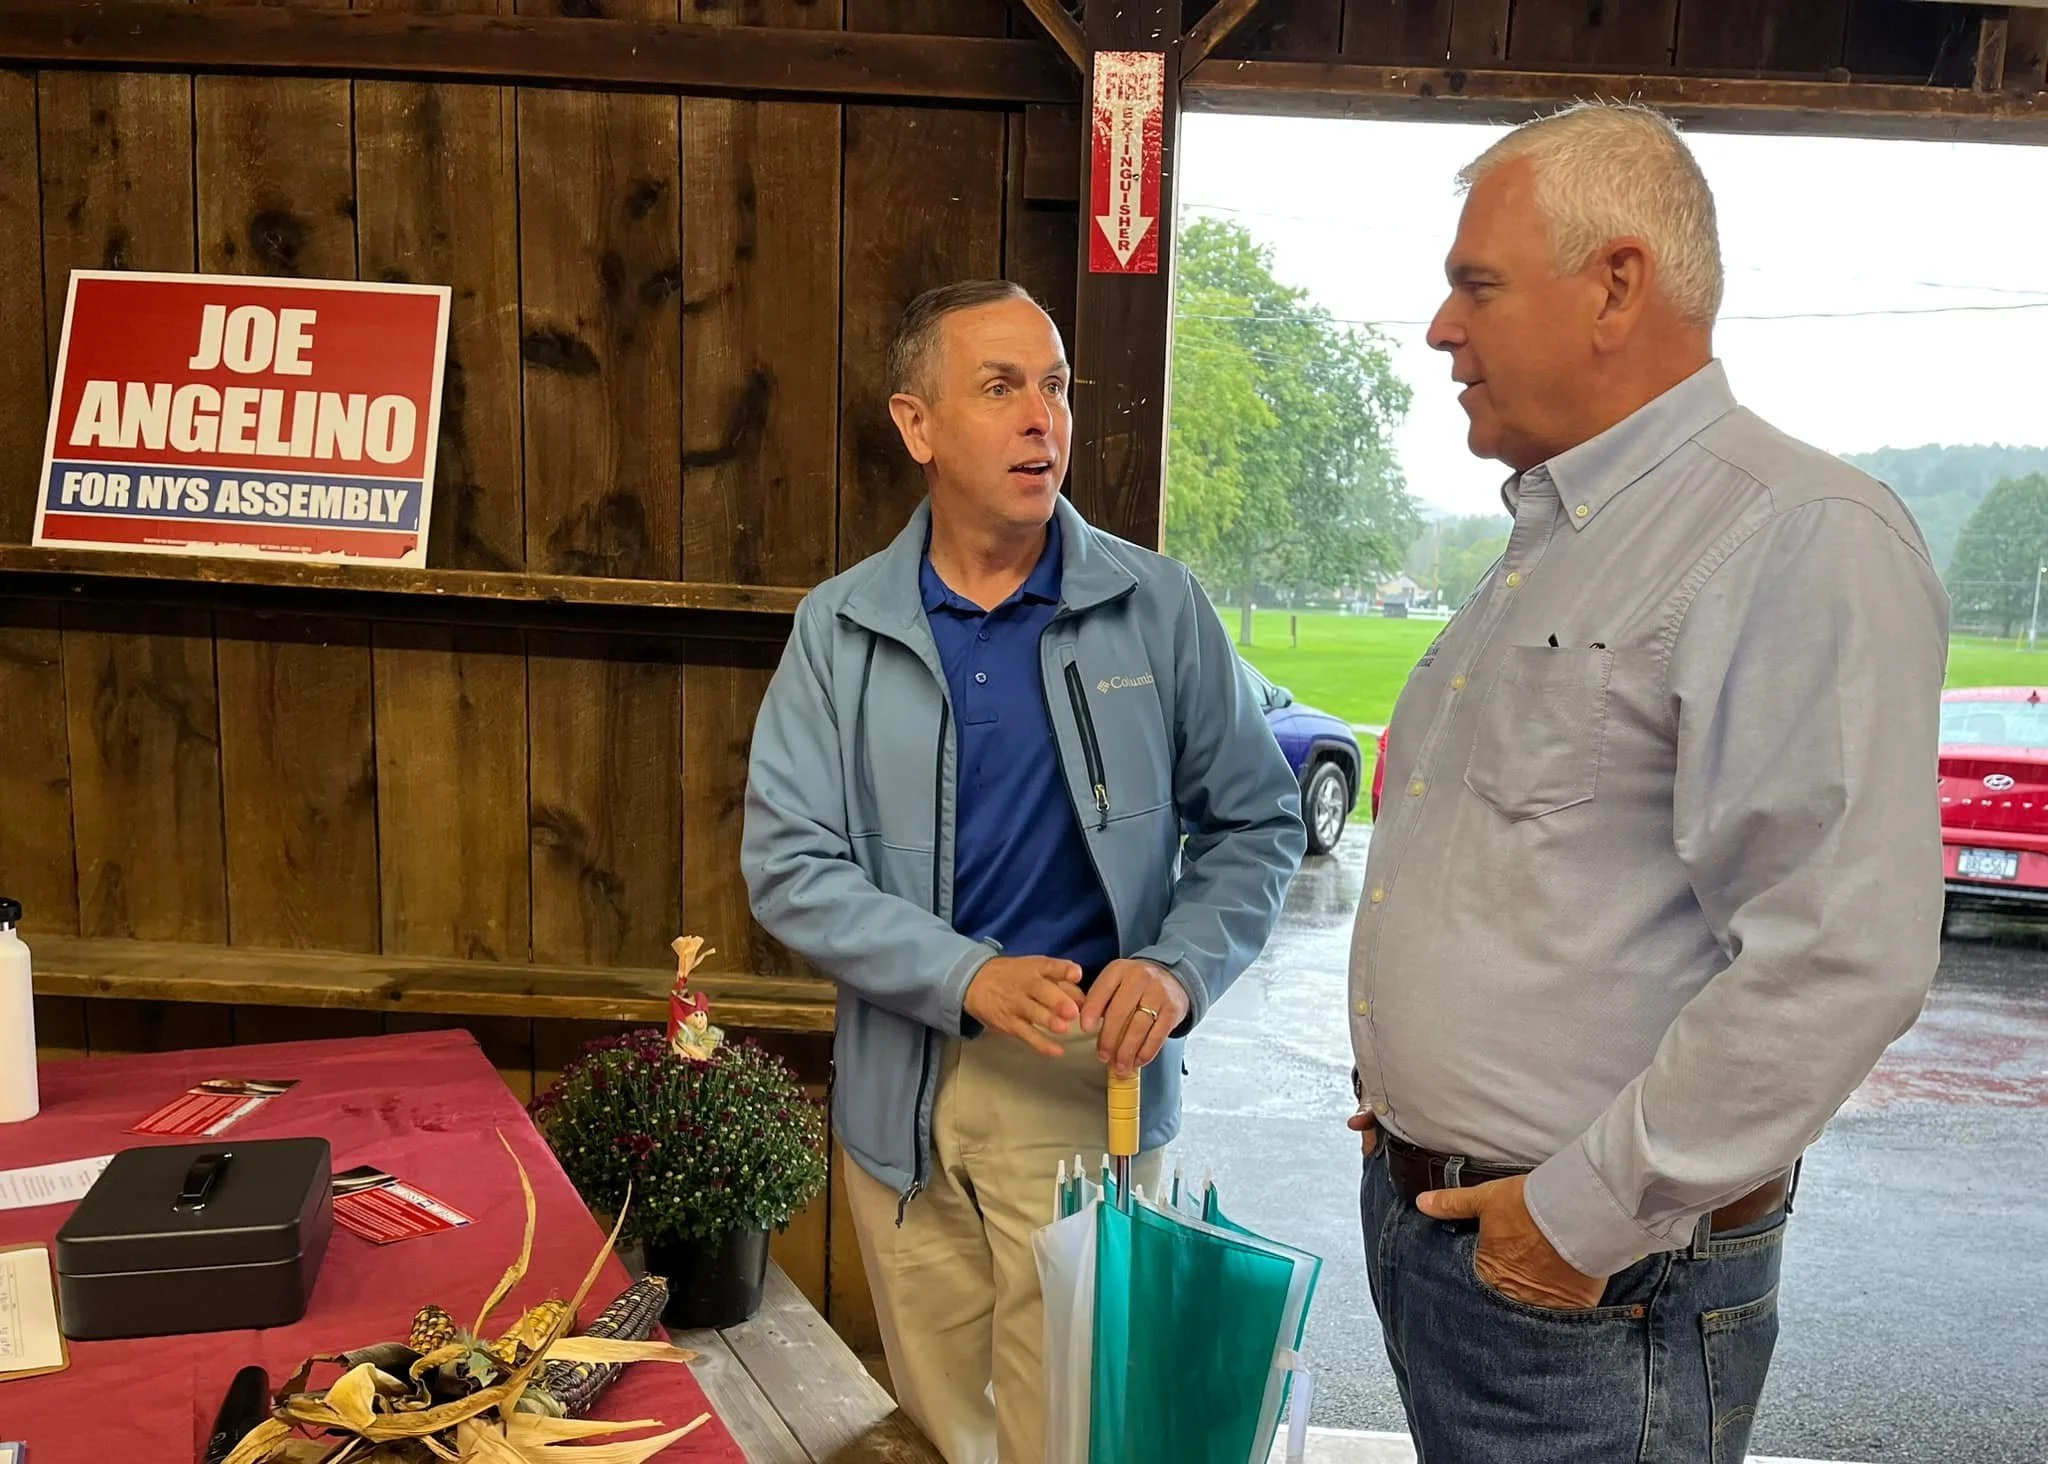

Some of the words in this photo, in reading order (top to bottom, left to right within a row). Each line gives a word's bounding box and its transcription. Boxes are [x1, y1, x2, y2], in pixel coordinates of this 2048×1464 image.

[1118, 107, 1134, 251] EXTINGUISHER
[189, 304, 317, 376] JOE
[69, 380, 417, 464] ANGELINO
[61, 471, 131, 507] FOR
[136, 475, 210, 512] NYS
[214, 479, 408, 523] ASSEMBLY
